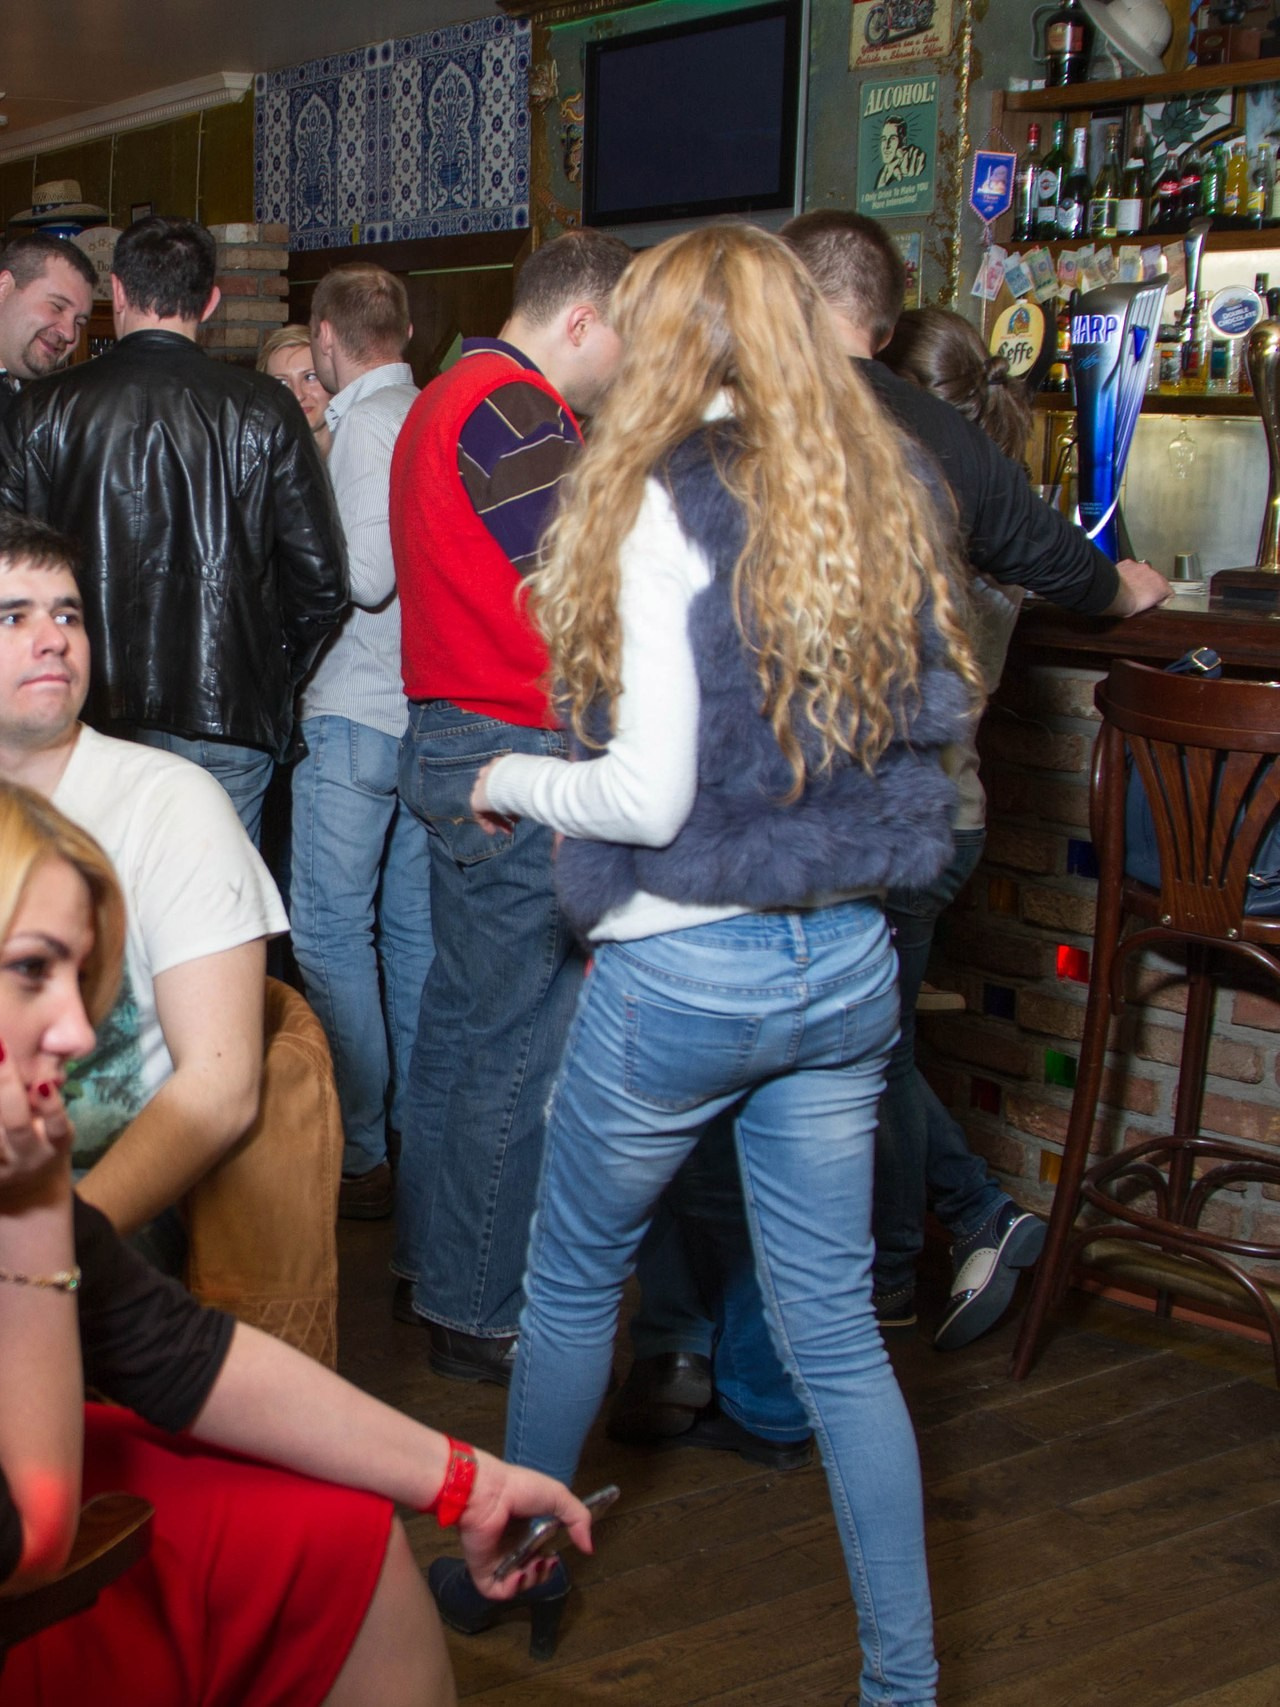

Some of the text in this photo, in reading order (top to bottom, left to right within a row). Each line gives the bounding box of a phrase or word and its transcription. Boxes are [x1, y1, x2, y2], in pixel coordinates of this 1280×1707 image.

[863, 81, 936, 117] ALCOHOL!
[1072, 315, 1119, 344] HARP
[999, 341, 1034, 364] Leffe
